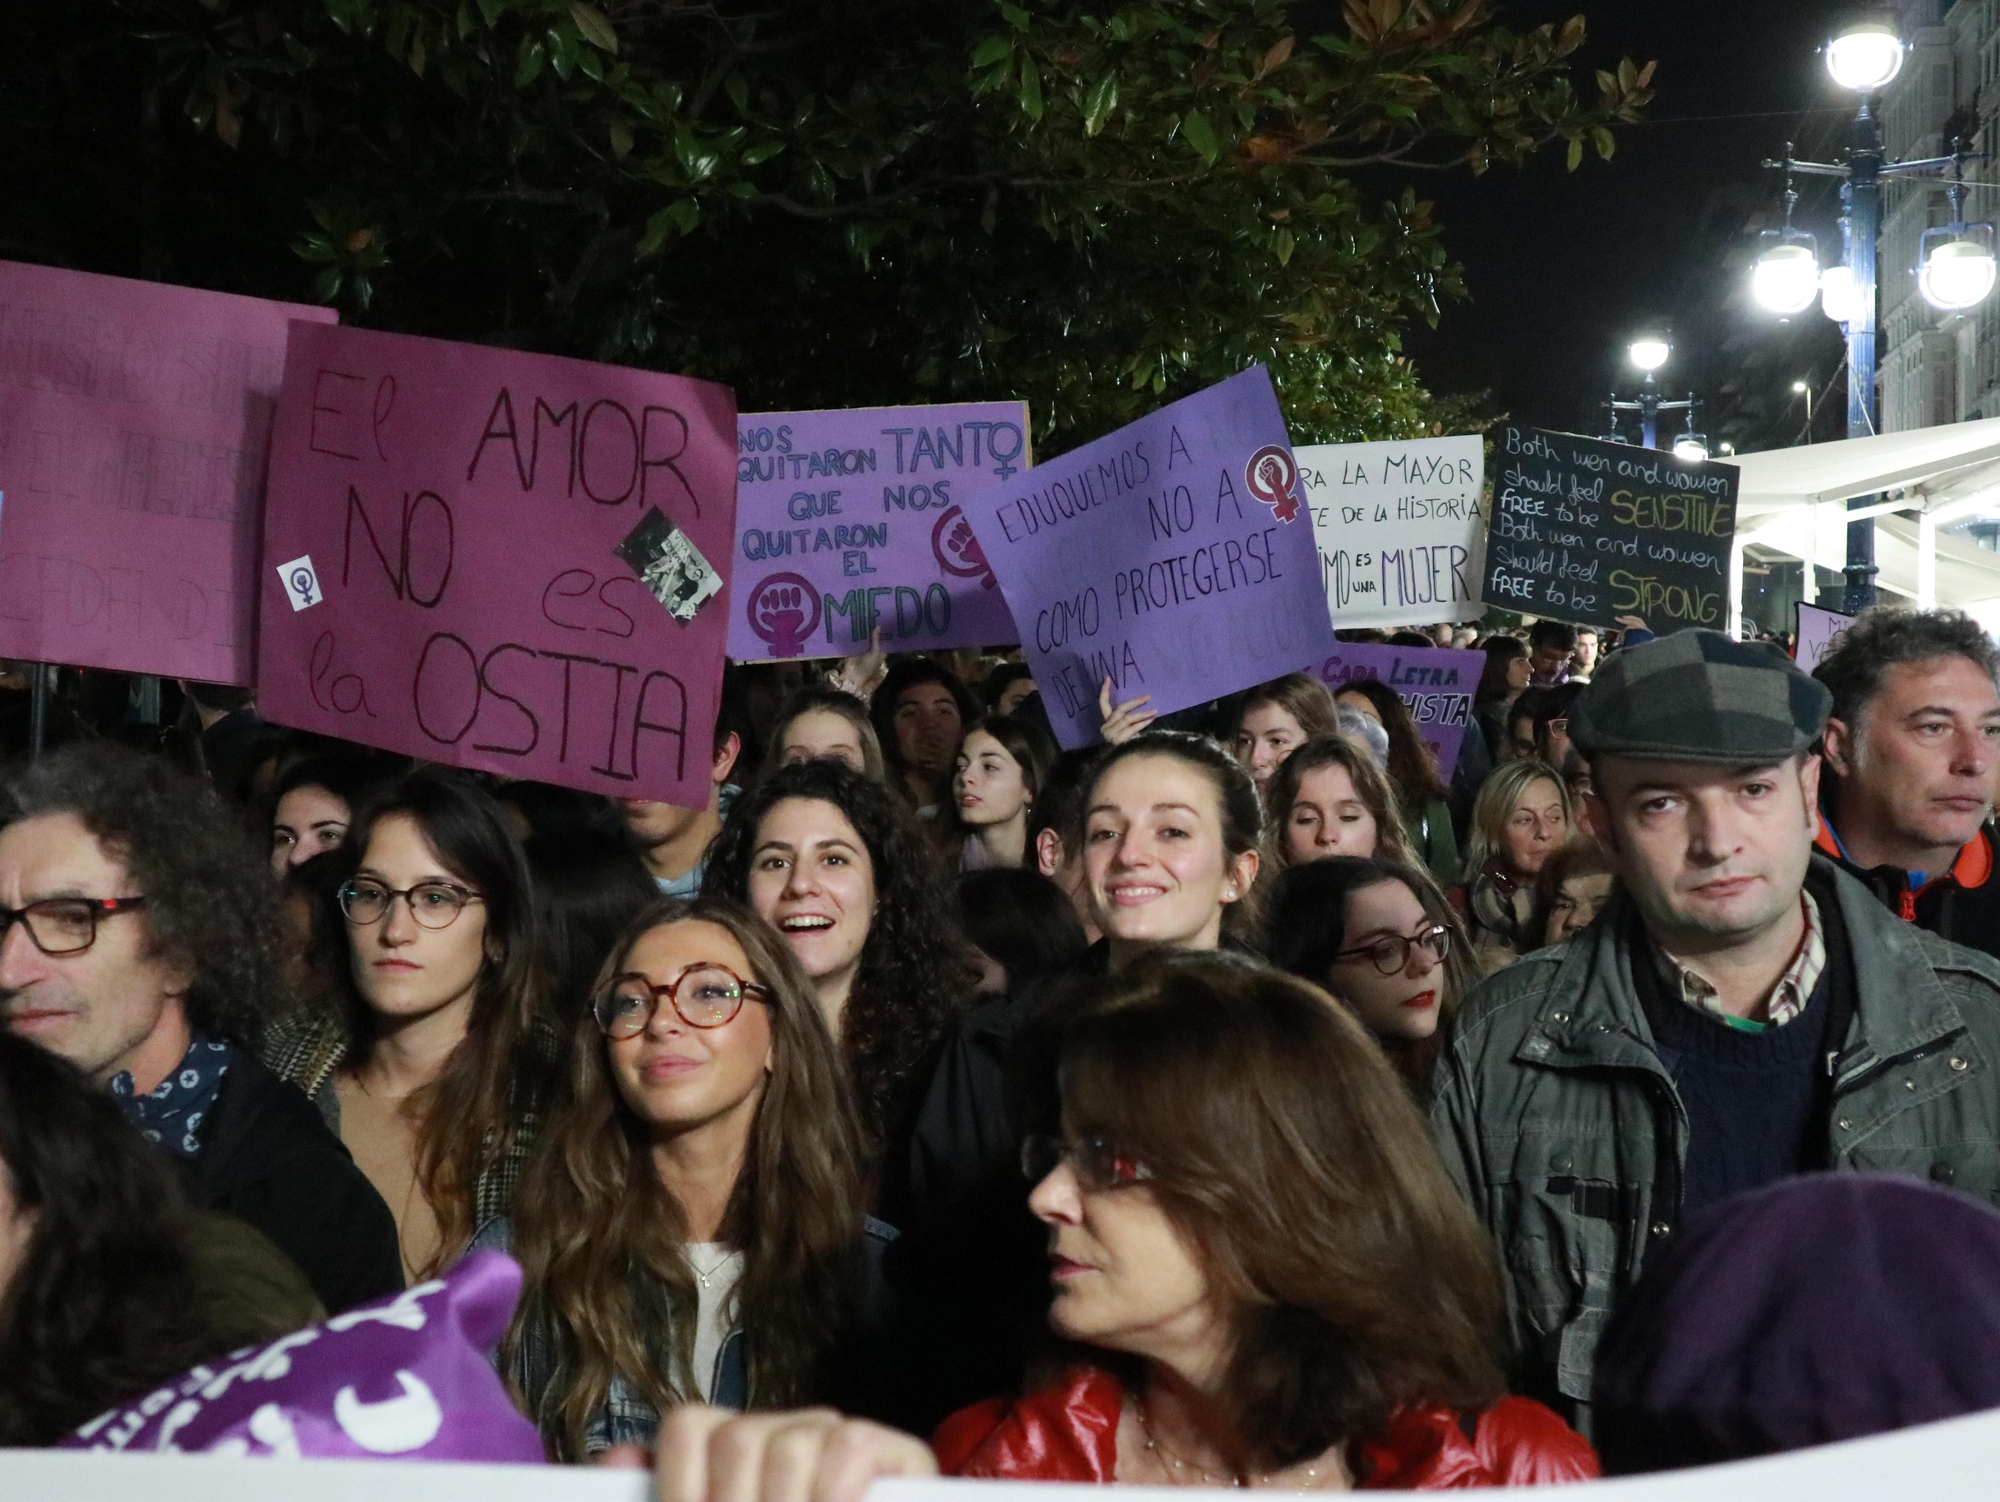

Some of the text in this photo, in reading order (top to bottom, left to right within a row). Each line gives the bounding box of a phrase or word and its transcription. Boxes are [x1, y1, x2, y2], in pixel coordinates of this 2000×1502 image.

[310, 369, 701, 520] El AMOR
[737, 425, 793, 453] NOS
[737, 421, 1023, 482] QUITARON TANTO
[1506, 427, 1561, 462] Both
[1618, 461, 1663, 484] and
[995, 424, 1193, 544] EDUQUEMOS A
[1342, 460, 1369, 485] LA
[1383, 453, 1474, 485] MAYOR
[1567, 474, 1604, 506] feel
[788, 480, 950, 521] QUE NOS
[1148, 468, 1244, 542] NO A
[1342, 503, 1364, 524] DE
[1374, 504, 1388, 523] LA
[1397, 493, 1482, 522] HISTORIA
[1555, 503, 1574, 522] to
[1579, 507, 1599, 527] be
[1611, 490, 1732, 537] SENSITIVE
[742, 522, 887, 561] QUITARON
[1493, 512, 1543, 541] Both
[1596, 535, 1639, 556] and
[342, 484, 454, 608] NO
[541, 567, 637, 639] es
[843, 550, 877, 577] EL
[1352, 580, 1377, 593] UNA
[1355, 552, 1372, 567] ES
[1381, 545, 1472, 607] MUJER
[1559, 549, 1598, 584] feel
[823, 582, 950, 644] MIEDO
[1035, 586, 1100, 654] COMO
[1114, 527, 1282, 620] PROTEGERSE
[1546, 581, 1565, 604] to
[1571, 586, 1596, 611] be
[1610, 569, 1719, 623] STRONG
[1052, 665, 1091, 718] DE
[1081, 640, 1145, 697] UNA
[1389, 657, 1459, 686] LETRA
[309, 629, 689, 783] la OSTIA
